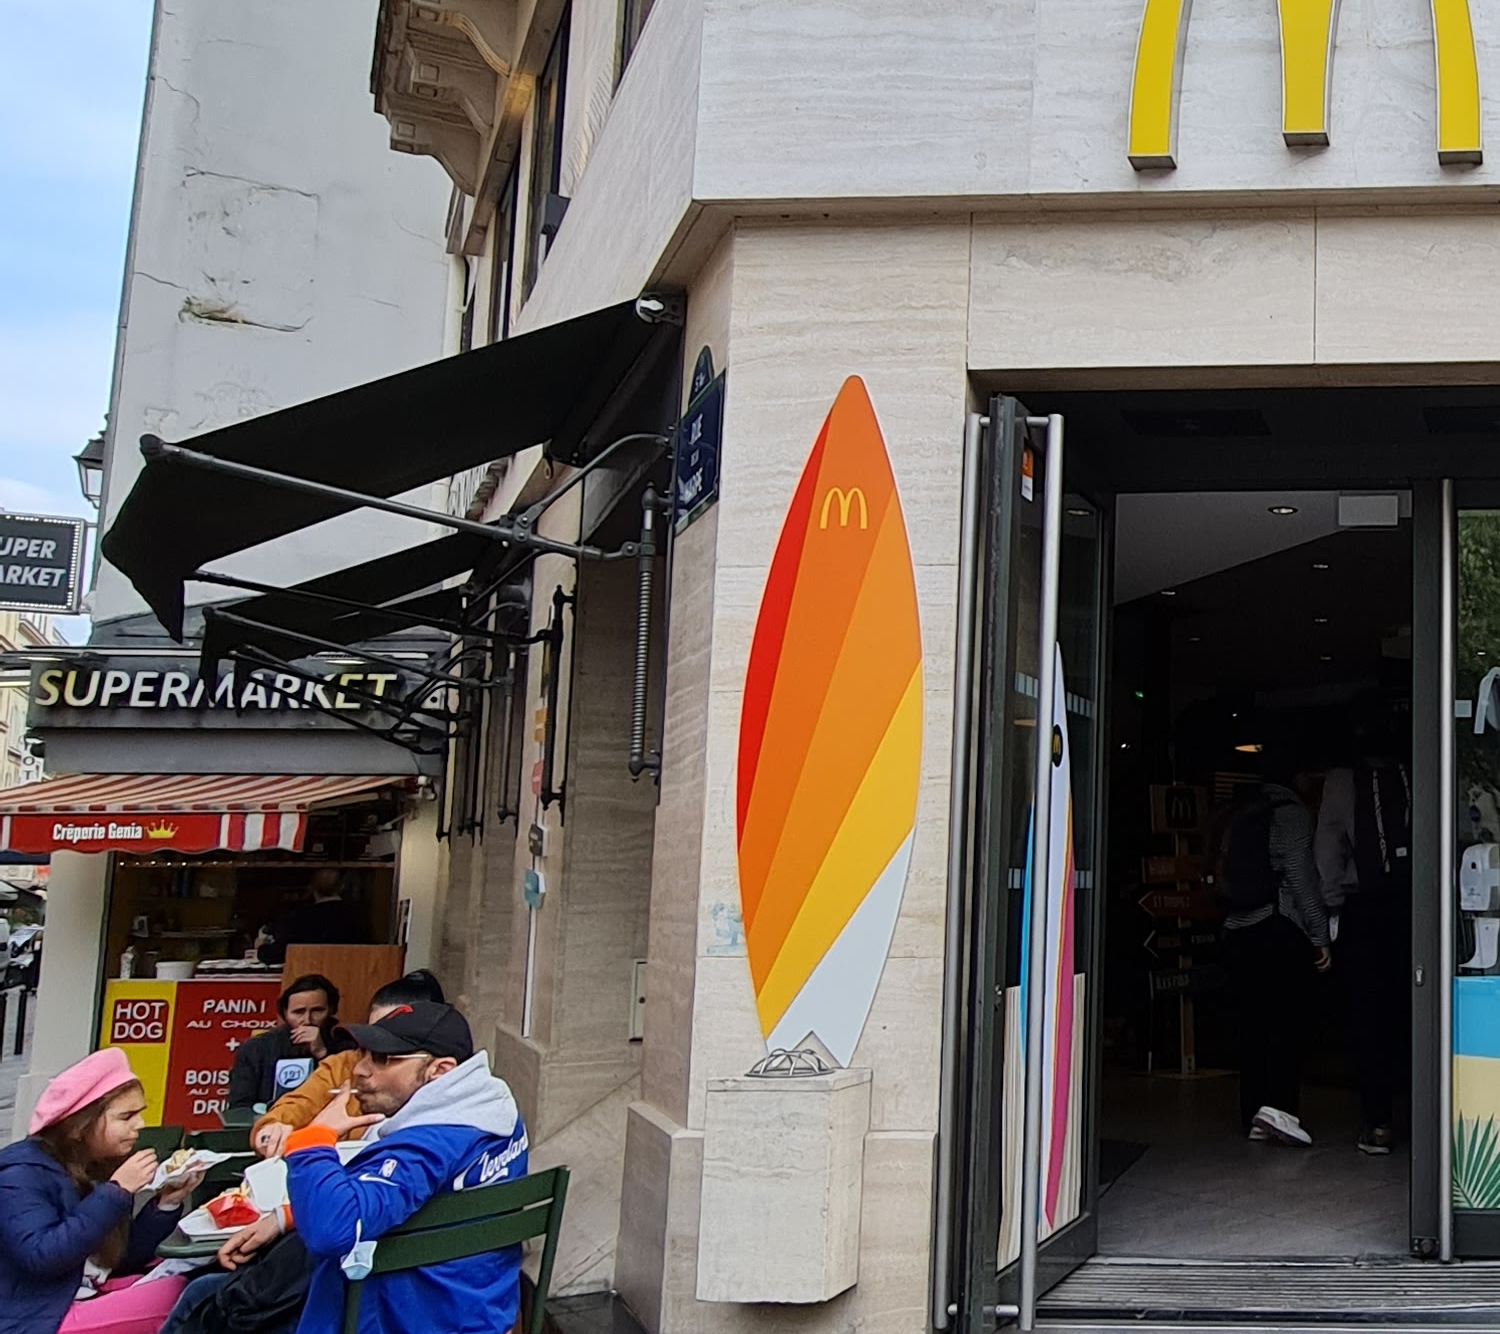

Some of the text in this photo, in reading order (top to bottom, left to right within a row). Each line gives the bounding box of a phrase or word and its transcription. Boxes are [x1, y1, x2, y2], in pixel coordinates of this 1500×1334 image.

[0, 535, 56, 559] UPER
[108, 822, 142, 839] Genia
[115, 1001, 166, 1020] HOT
[113, 1022, 164, 1040] DOG
[186, 1020, 278, 1029] AU CHOIX
[185, 1070, 230, 1085] BOIS
[193, 1099, 230, 1115] DRI
